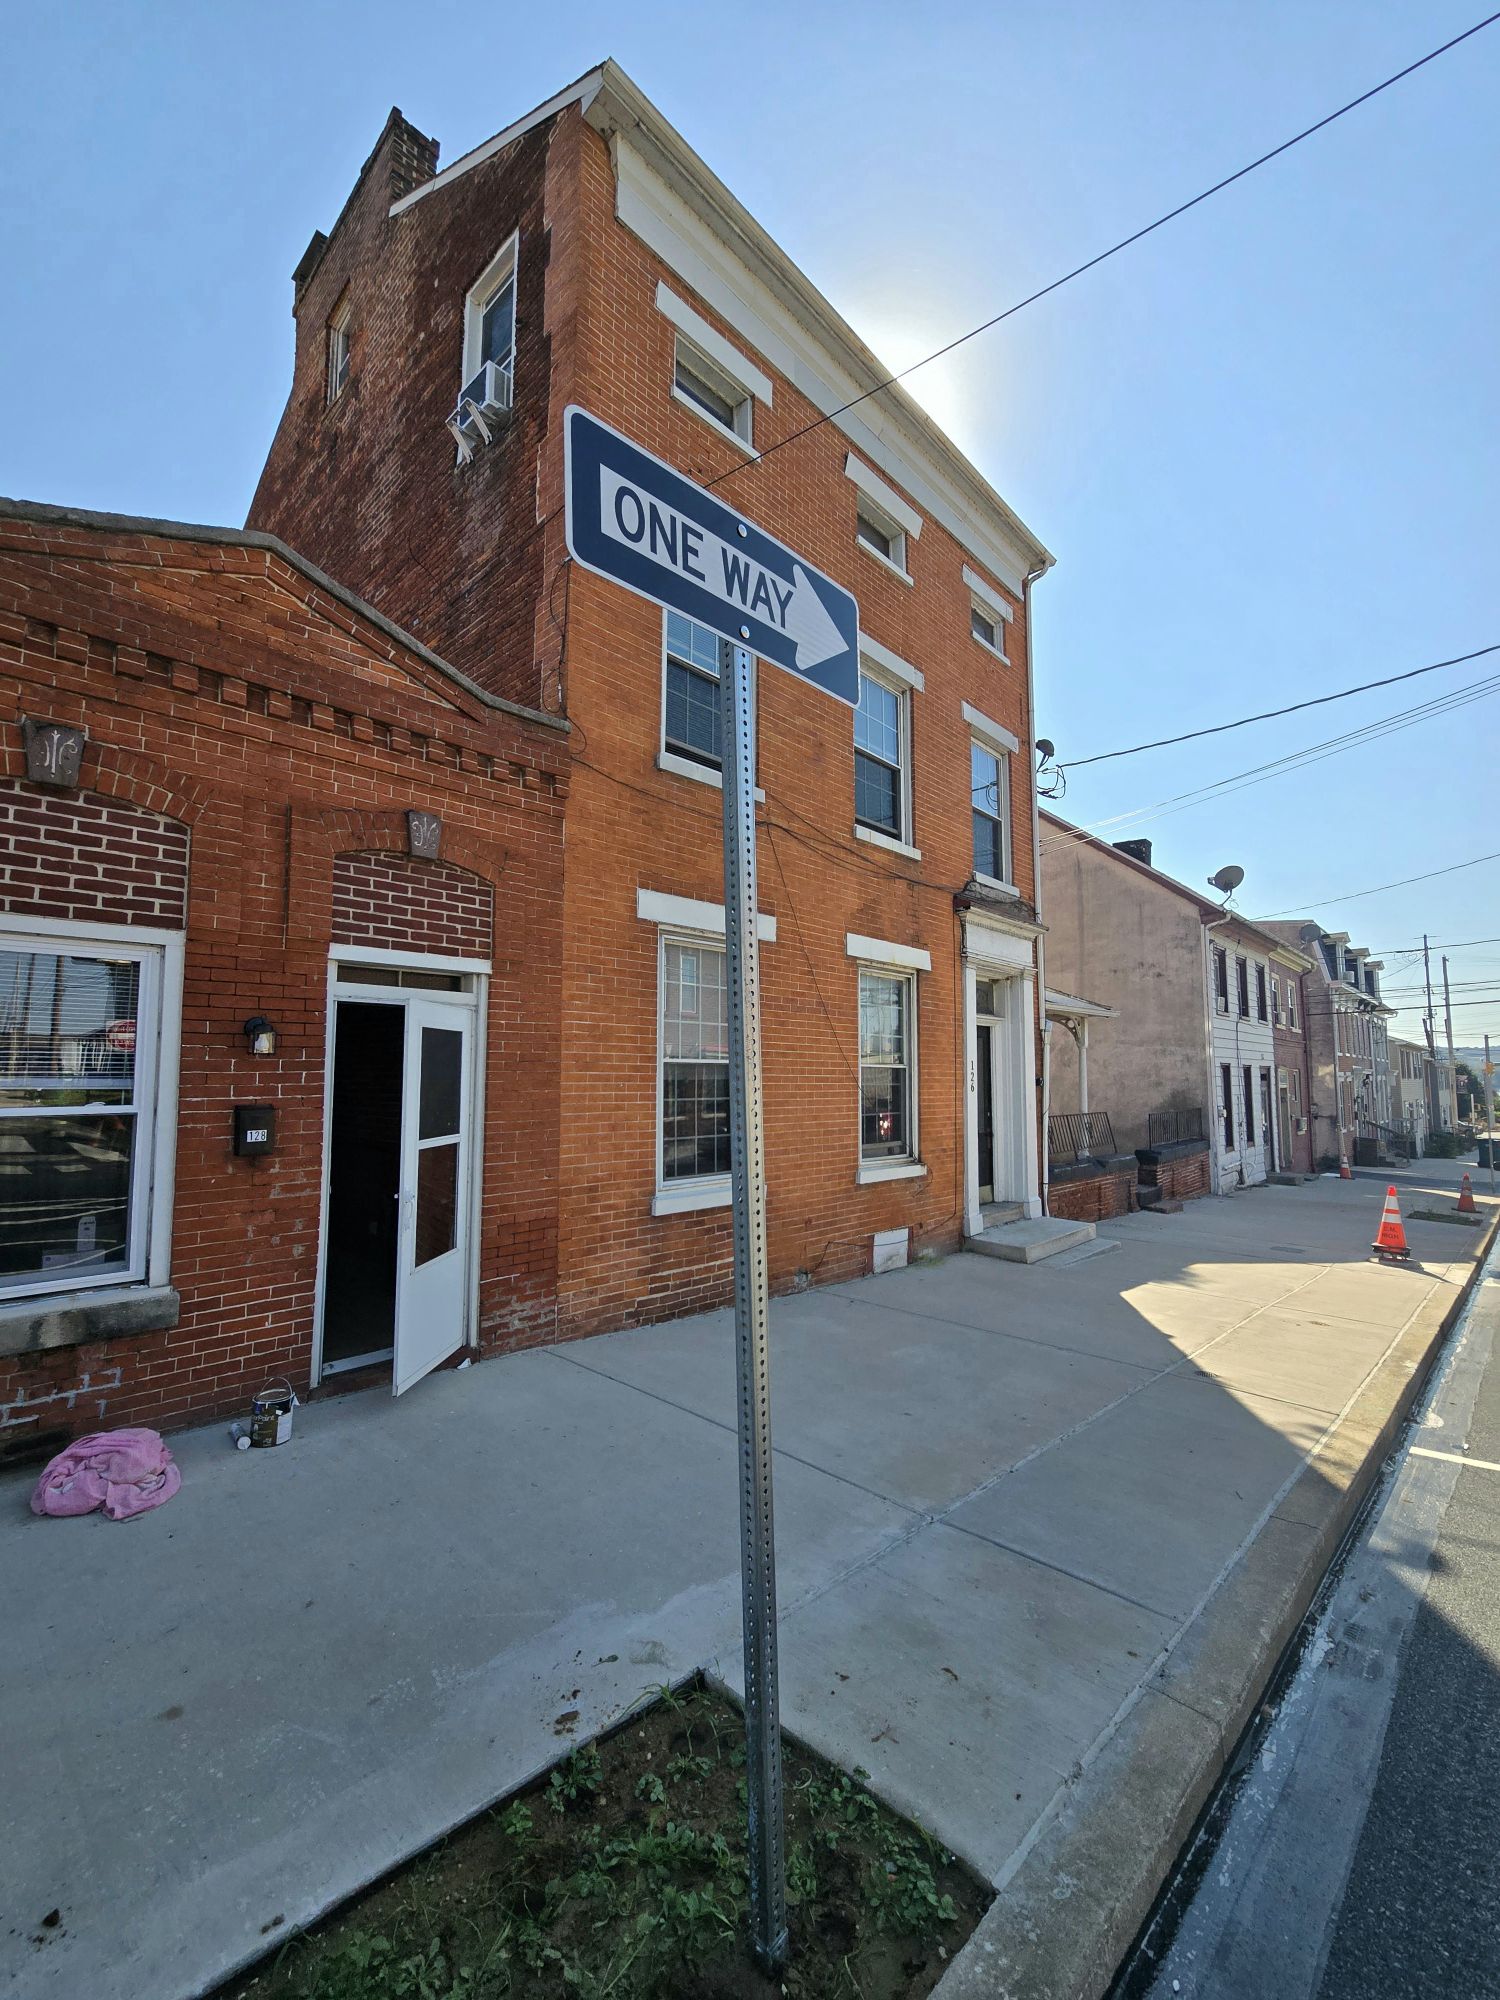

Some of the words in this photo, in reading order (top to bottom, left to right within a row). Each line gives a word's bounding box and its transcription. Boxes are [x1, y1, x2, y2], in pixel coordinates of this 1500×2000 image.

[614, 485, 706, 583] ONE
[721, 545, 794, 629] WAY
[249, 1130, 266, 1141] 128
